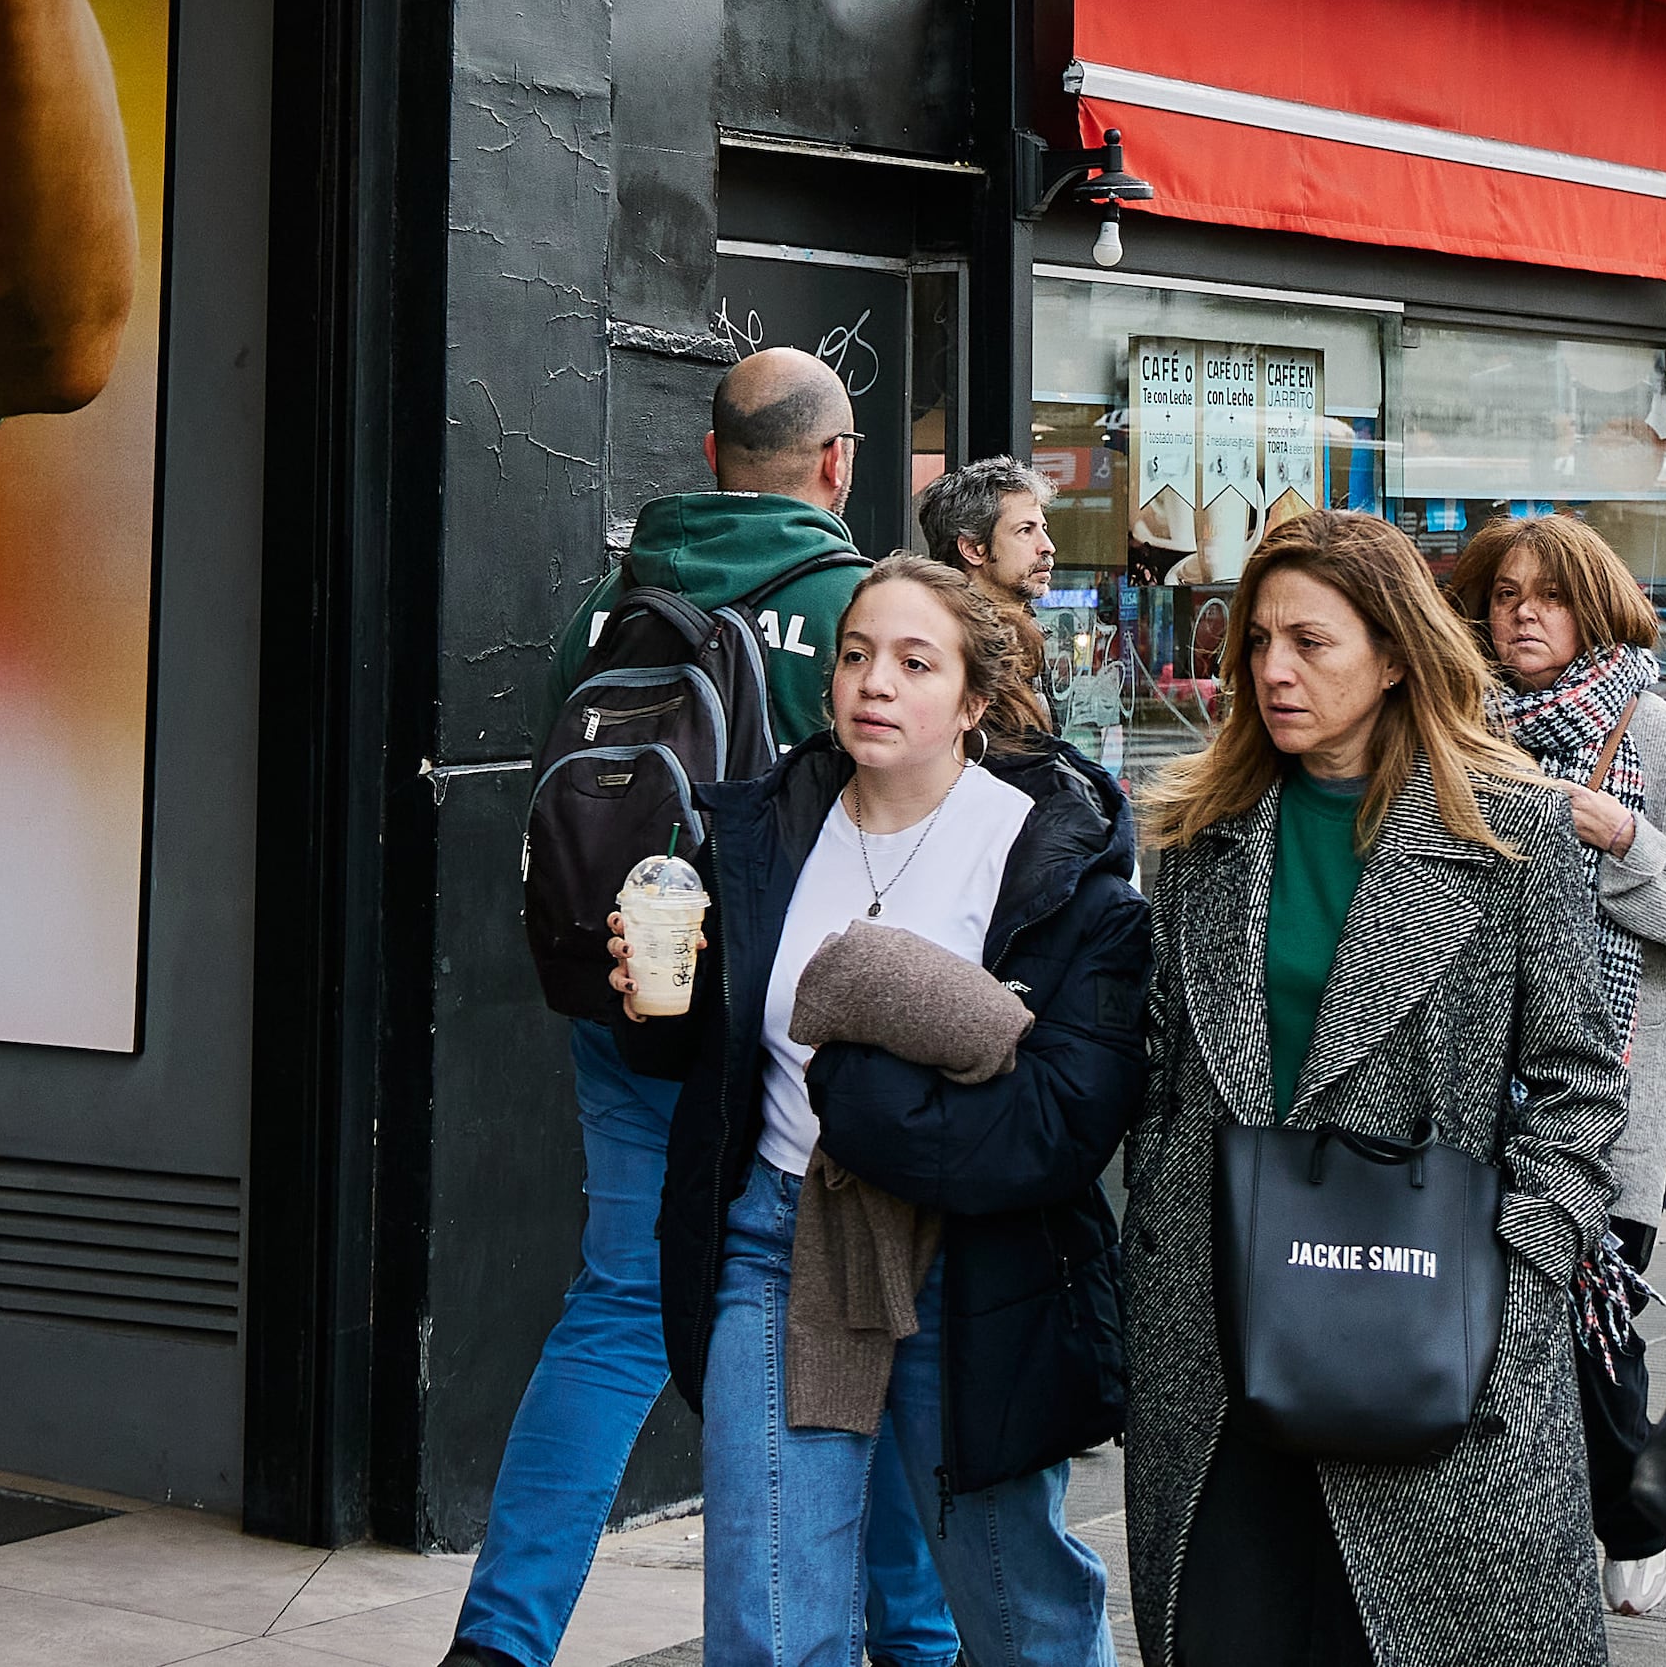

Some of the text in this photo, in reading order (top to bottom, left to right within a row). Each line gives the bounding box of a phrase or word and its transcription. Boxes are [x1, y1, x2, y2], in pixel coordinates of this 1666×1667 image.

[1141, 349, 1180, 383] CAFÉ
[1206, 355, 1255, 383] CAFÉ O TÉ
[1267, 357, 1314, 389] CAFÉ EN
[1142, 387, 1194, 406] Te con Leche
[1206, 387, 1255, 408] con Leche
[1267, 390, 1315, 410] JARRITO
[1267, 441, 1289, 455] TORTA
[1287, 1240, 1437, 1278] JACKIE SMITH
